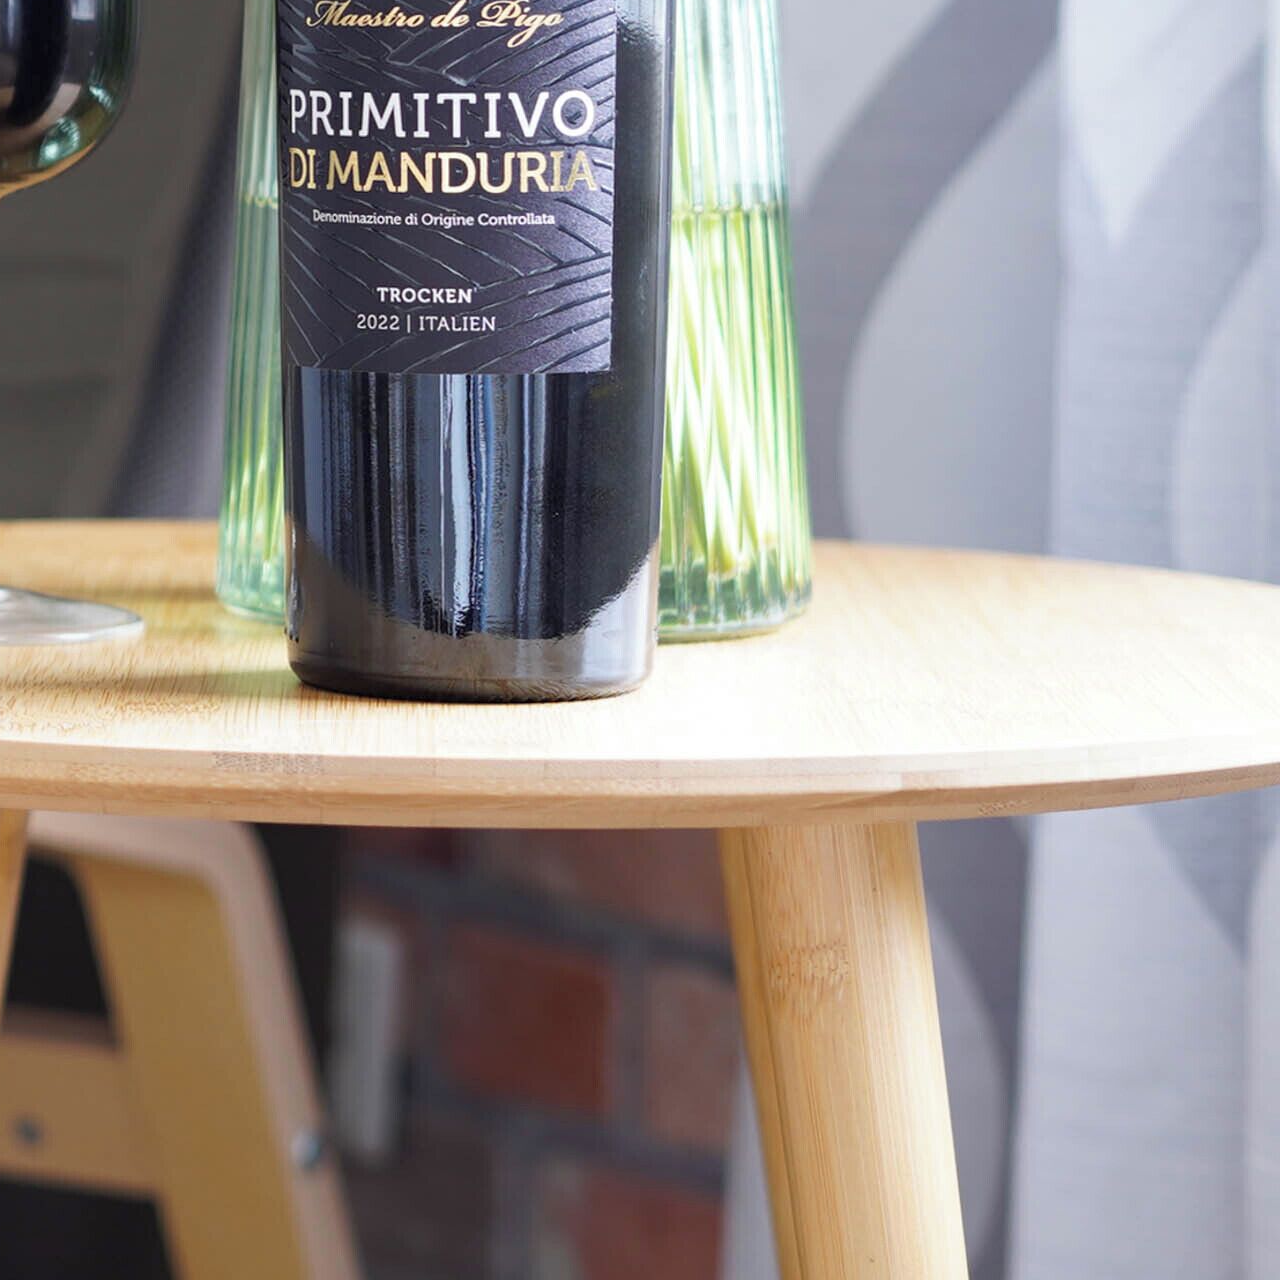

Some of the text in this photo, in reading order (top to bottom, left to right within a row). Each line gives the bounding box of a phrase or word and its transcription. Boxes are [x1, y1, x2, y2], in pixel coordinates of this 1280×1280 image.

[431, 0, 469, 28] de
[289, 88, 596, 138] PRIMITIVO
[289, 147, 597, 193] DI MANDURIA
[312, 208, 556, 229] Denominazione di Origine Controllata
[376, 286, 472, 303] TROCKEN
[356, 314, 400, 331] 2022
[419, 316, 496, 332] ITALIEN
